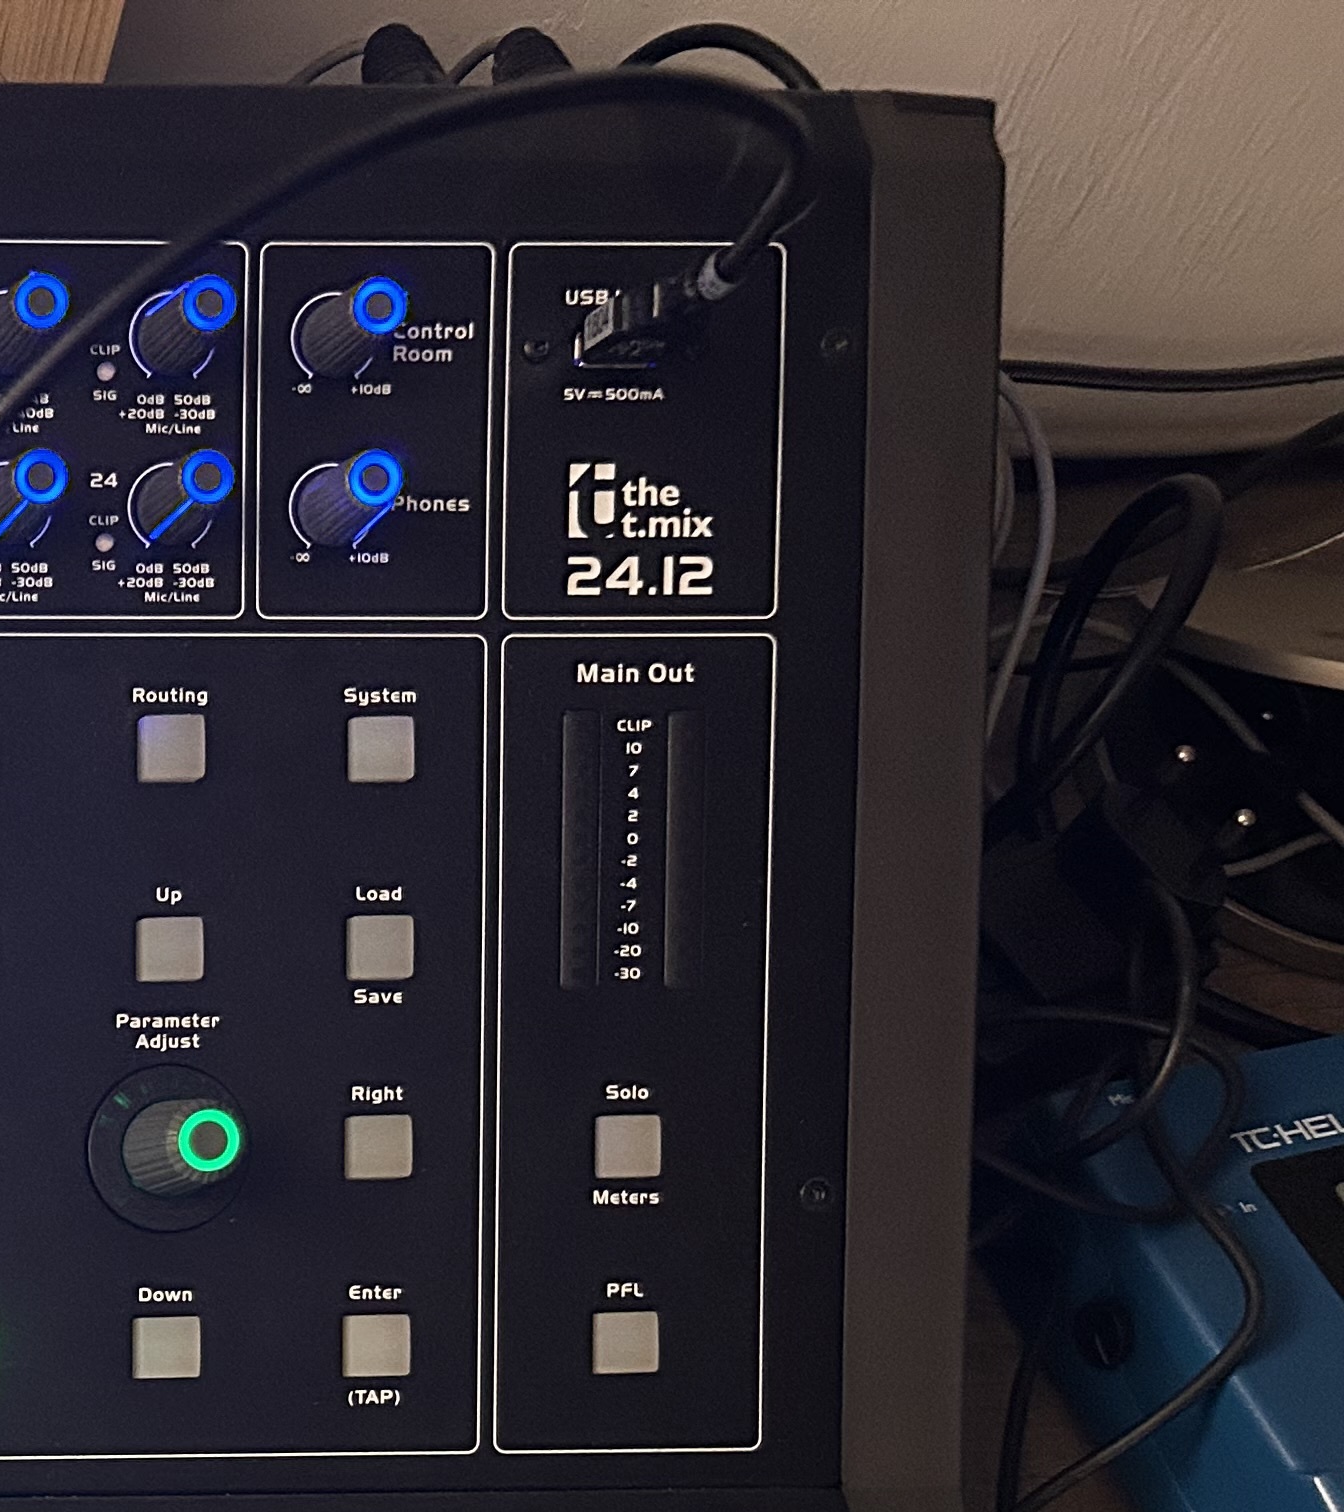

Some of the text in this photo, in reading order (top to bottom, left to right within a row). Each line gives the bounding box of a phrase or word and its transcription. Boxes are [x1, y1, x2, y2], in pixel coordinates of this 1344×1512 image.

[566, 290, 609, 305] USB
[394, 346, 452, 362] Room
[352, 384, 391, 394] +10dB
[91, 473, 117, 487] 24
[622, 477, 679, 506] the
[621, 508, 713, 538] t.mix
[92, 560, 115, 570] SIG
[567, 556, 713, 595] 24.12
[577, 663, 694, 682] Main Out
[133, 688, 207, 706] Routing
[344, 688, 416, 706] System
[617, 720, 651, 731] CLIP
[626, 742, 642, 754] 10
[156, 887, 182, 905] Up
[356, 887, 402, 901] Load
[617, 923, 639, 934] -10
[614, 945, 641, 956] -20
[615, 968, 640, 979] -30
[354, 989, 402, 1003] Save
[116, 1013, 219, 1028] Parameter
[136, 1034, 199, 1051] Adjust
[352, 1086, 403, 1104] Right
[606, 1085, 648, 1099] Solo
[593, 1190, 659, 1204] Meters
[139, 1288, 192, 1301] Down
[349, 1285, 401, 1299] Enter
[607, 1283, 643, 1297] PFL
[348, 1390, 400, 1406] (TAP)
